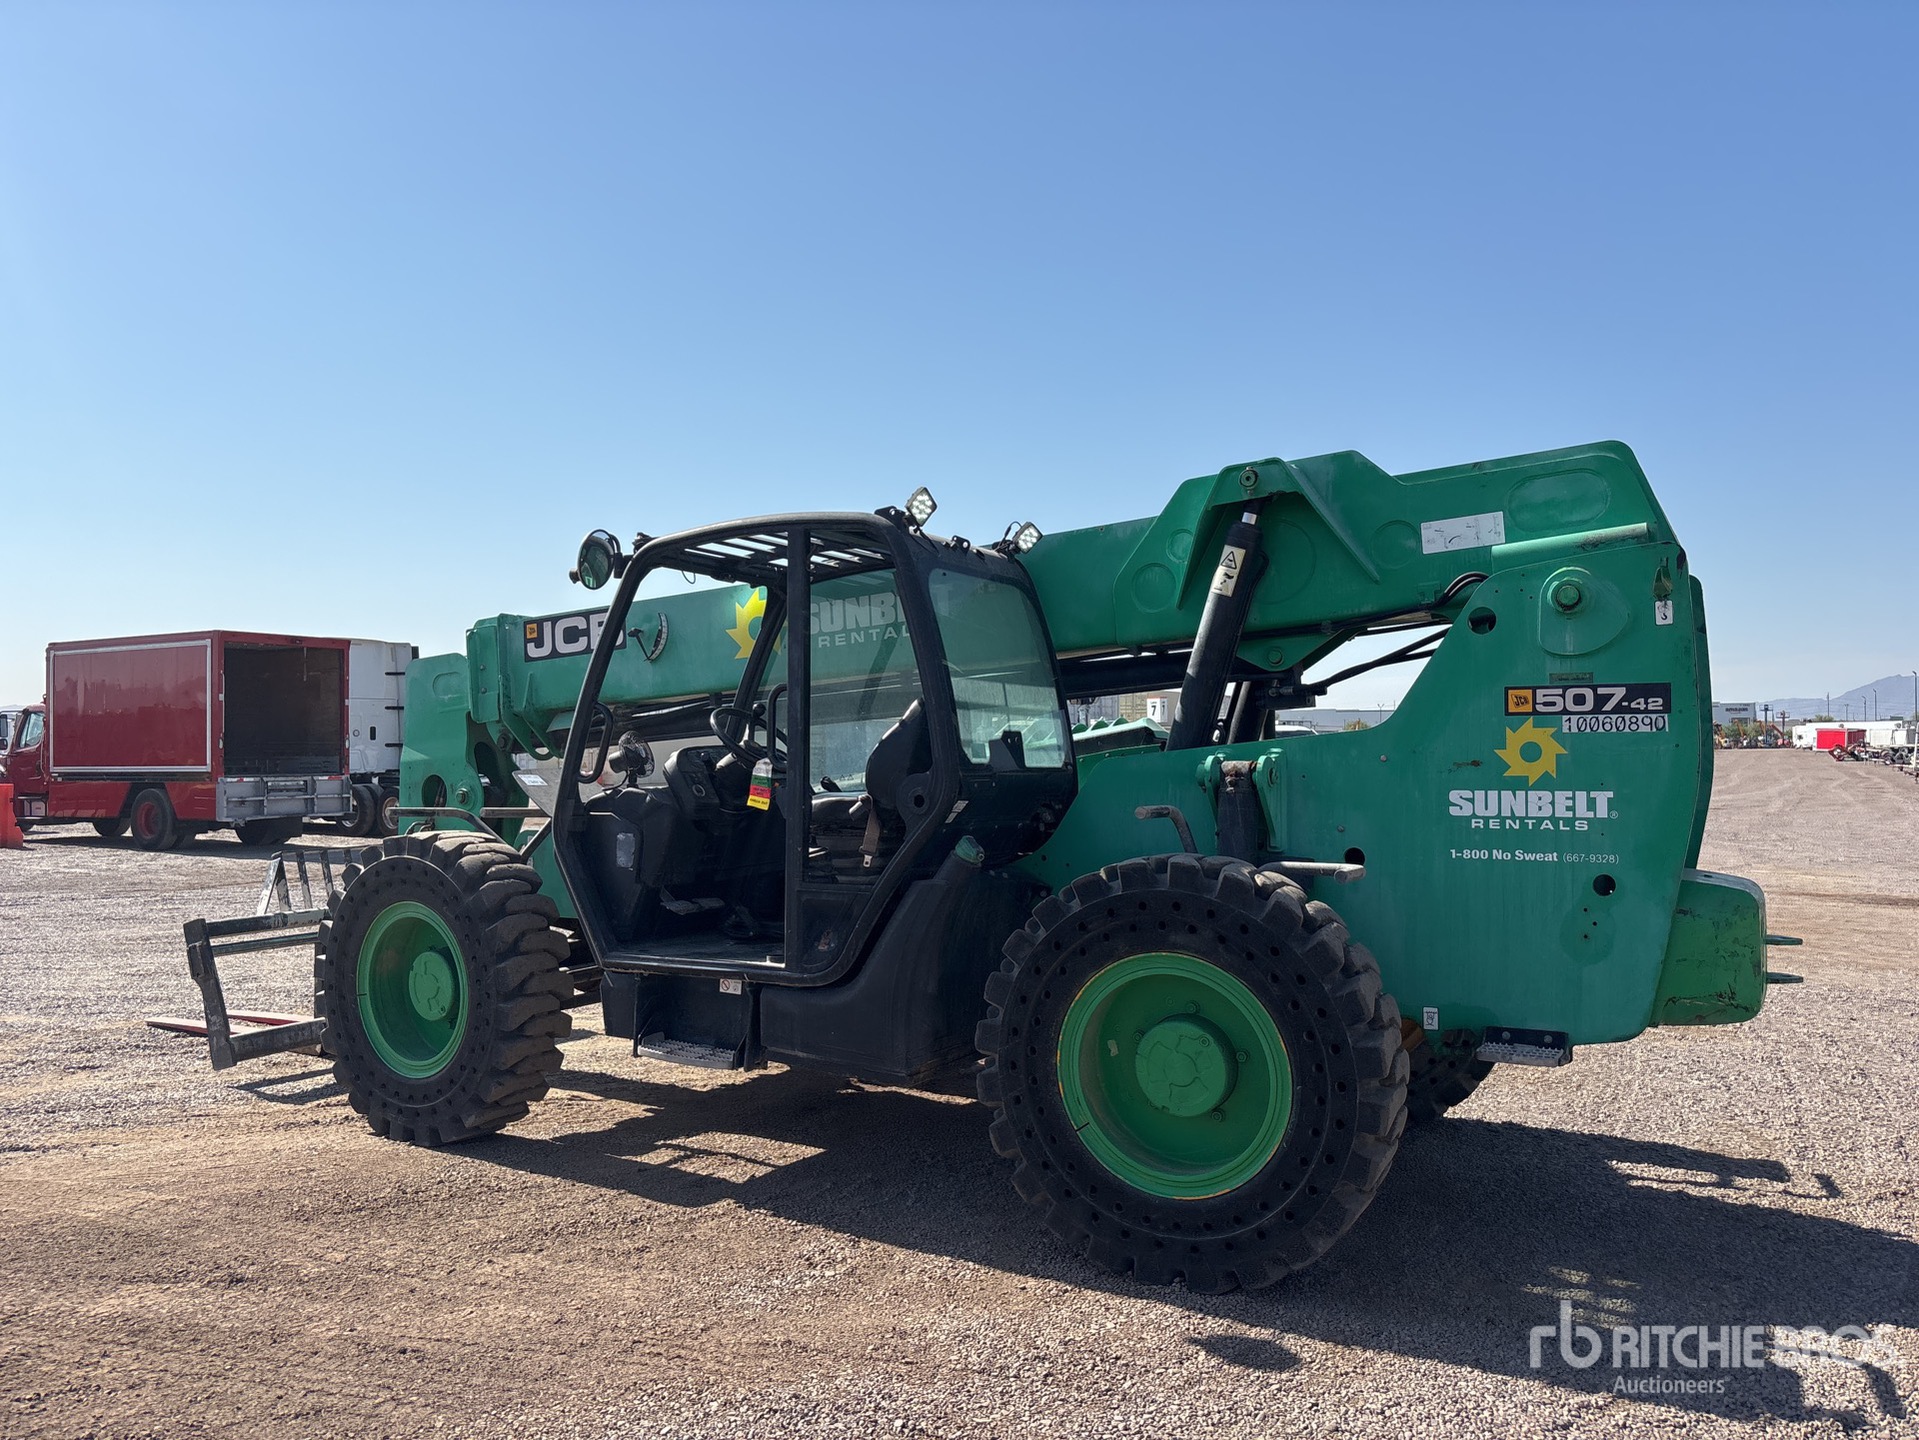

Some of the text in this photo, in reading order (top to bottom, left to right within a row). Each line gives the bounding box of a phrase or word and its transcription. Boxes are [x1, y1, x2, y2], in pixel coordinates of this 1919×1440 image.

[818, 625, 910, 648] RENTAL
[1535, 687, 1663, 712] 507-42
[1564, 715, 1666, 732] 10060890
[1448, 790, 1614, 818] SUNBELT
[1471, 819, 1589, 831] RENTALS
[1450, 849, 1620, 865] 1-800 No Sweat (667-9328)
